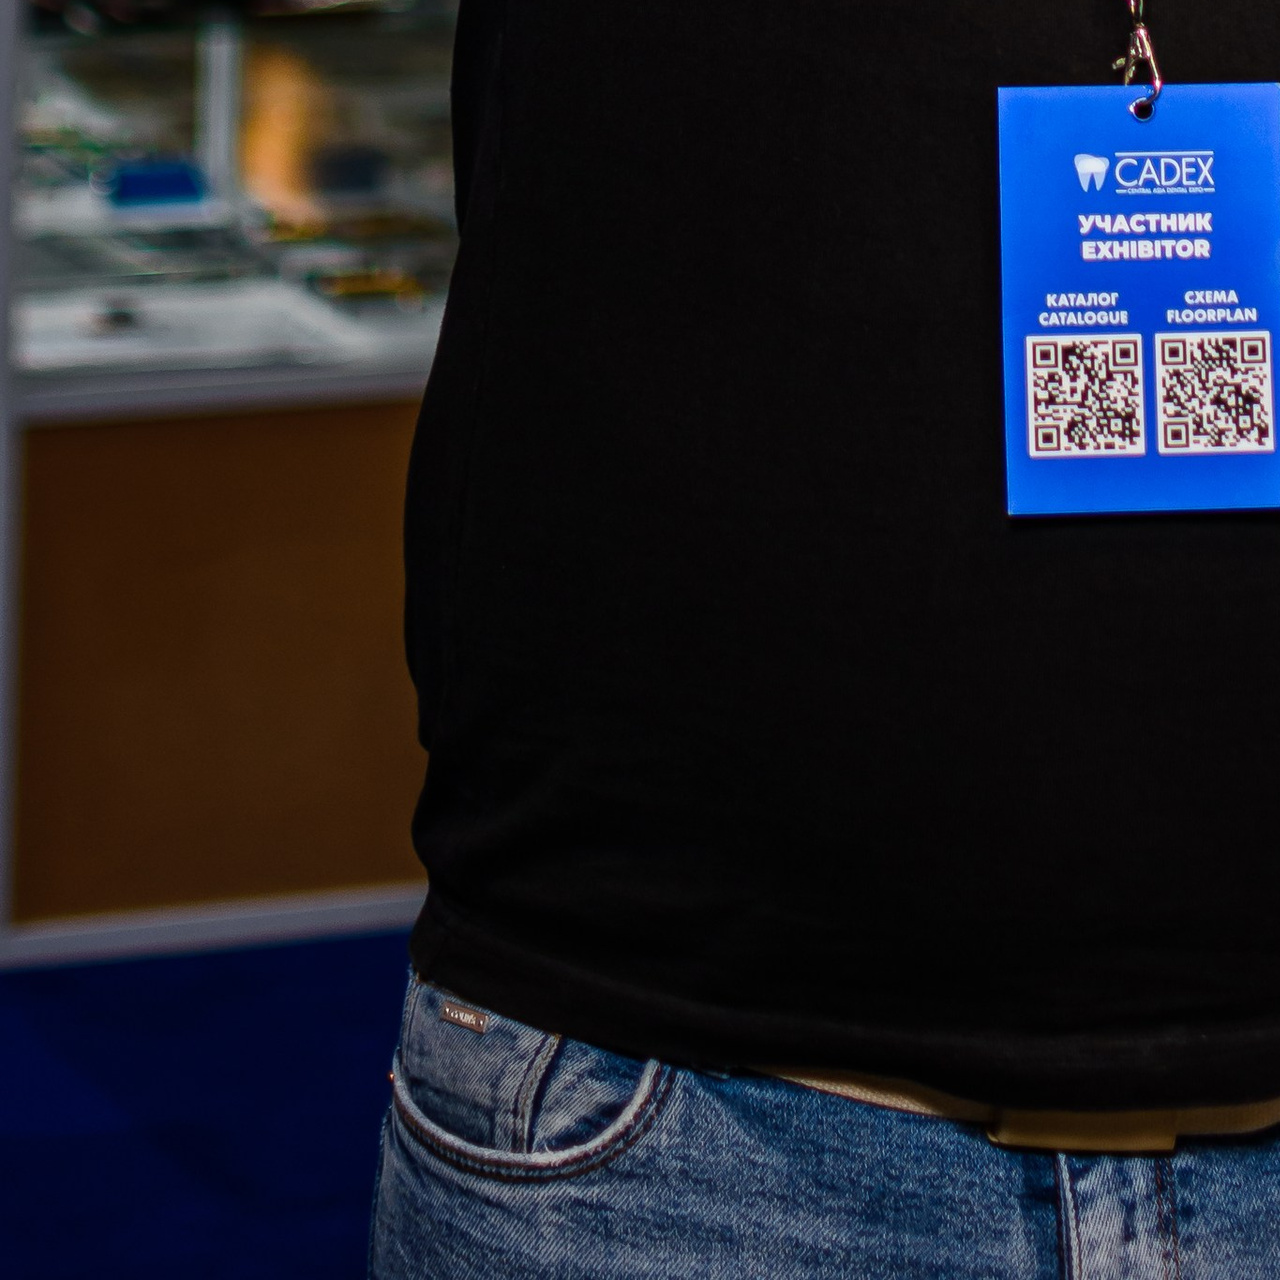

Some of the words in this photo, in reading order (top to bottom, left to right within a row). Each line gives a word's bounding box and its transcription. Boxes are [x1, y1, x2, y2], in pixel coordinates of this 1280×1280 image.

[1115, 157, 1214, 187] CADEX
[1078, 212, 1213, 233] УЧАСТНИК
[1082, 239, 1210, 260] EXHIBITOR
[1046, 292, 1119, 308] КАТАЛОГ
[1184, 290, 1238, 305] СХЕМА
[1039, 311, 1128, 326] CATALOGUE
[1166, 308, 1257, 324] FLOORPLAN
